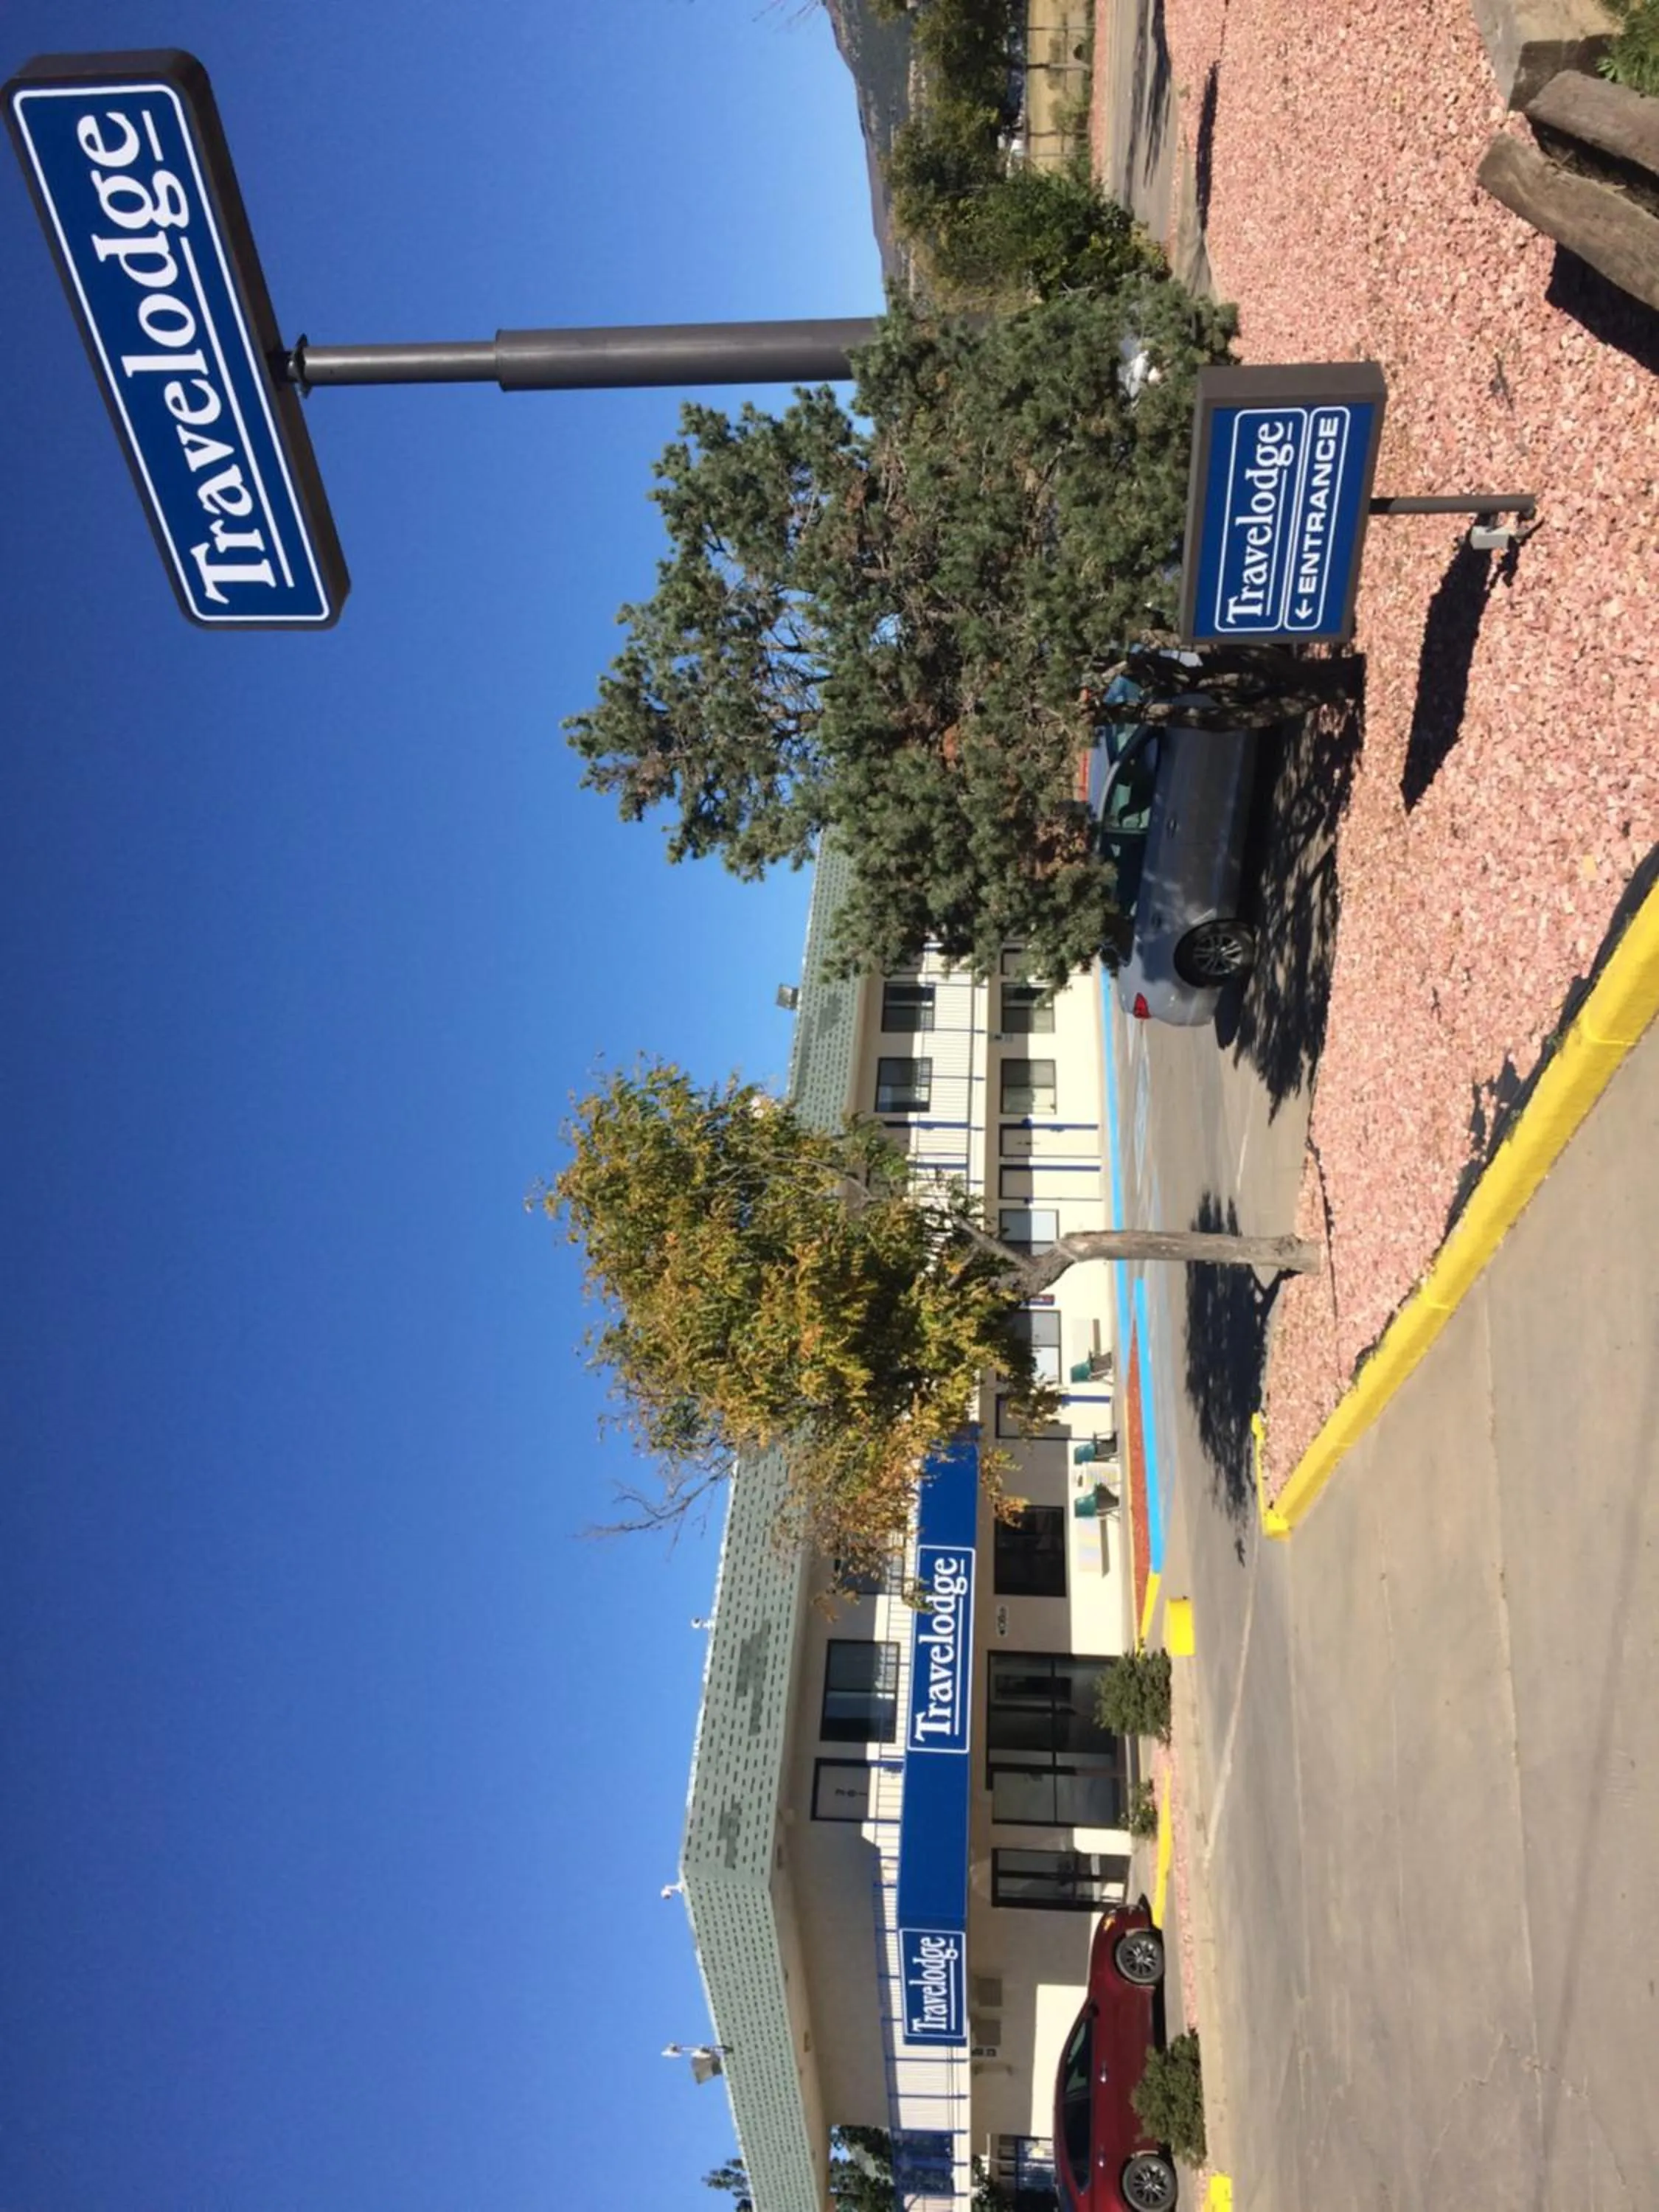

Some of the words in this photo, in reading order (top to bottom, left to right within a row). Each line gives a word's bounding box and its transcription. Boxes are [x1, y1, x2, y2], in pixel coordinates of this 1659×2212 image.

[77, 112, 276, 603] Travelodge
[1226, 422, 1294, 624] Travelodge
[1298, 417, 1339, 594] ENTRANCE
[914, 1557, 968, 1742] Travelodge
[908, 1937, 959, 2032] Travelodge
